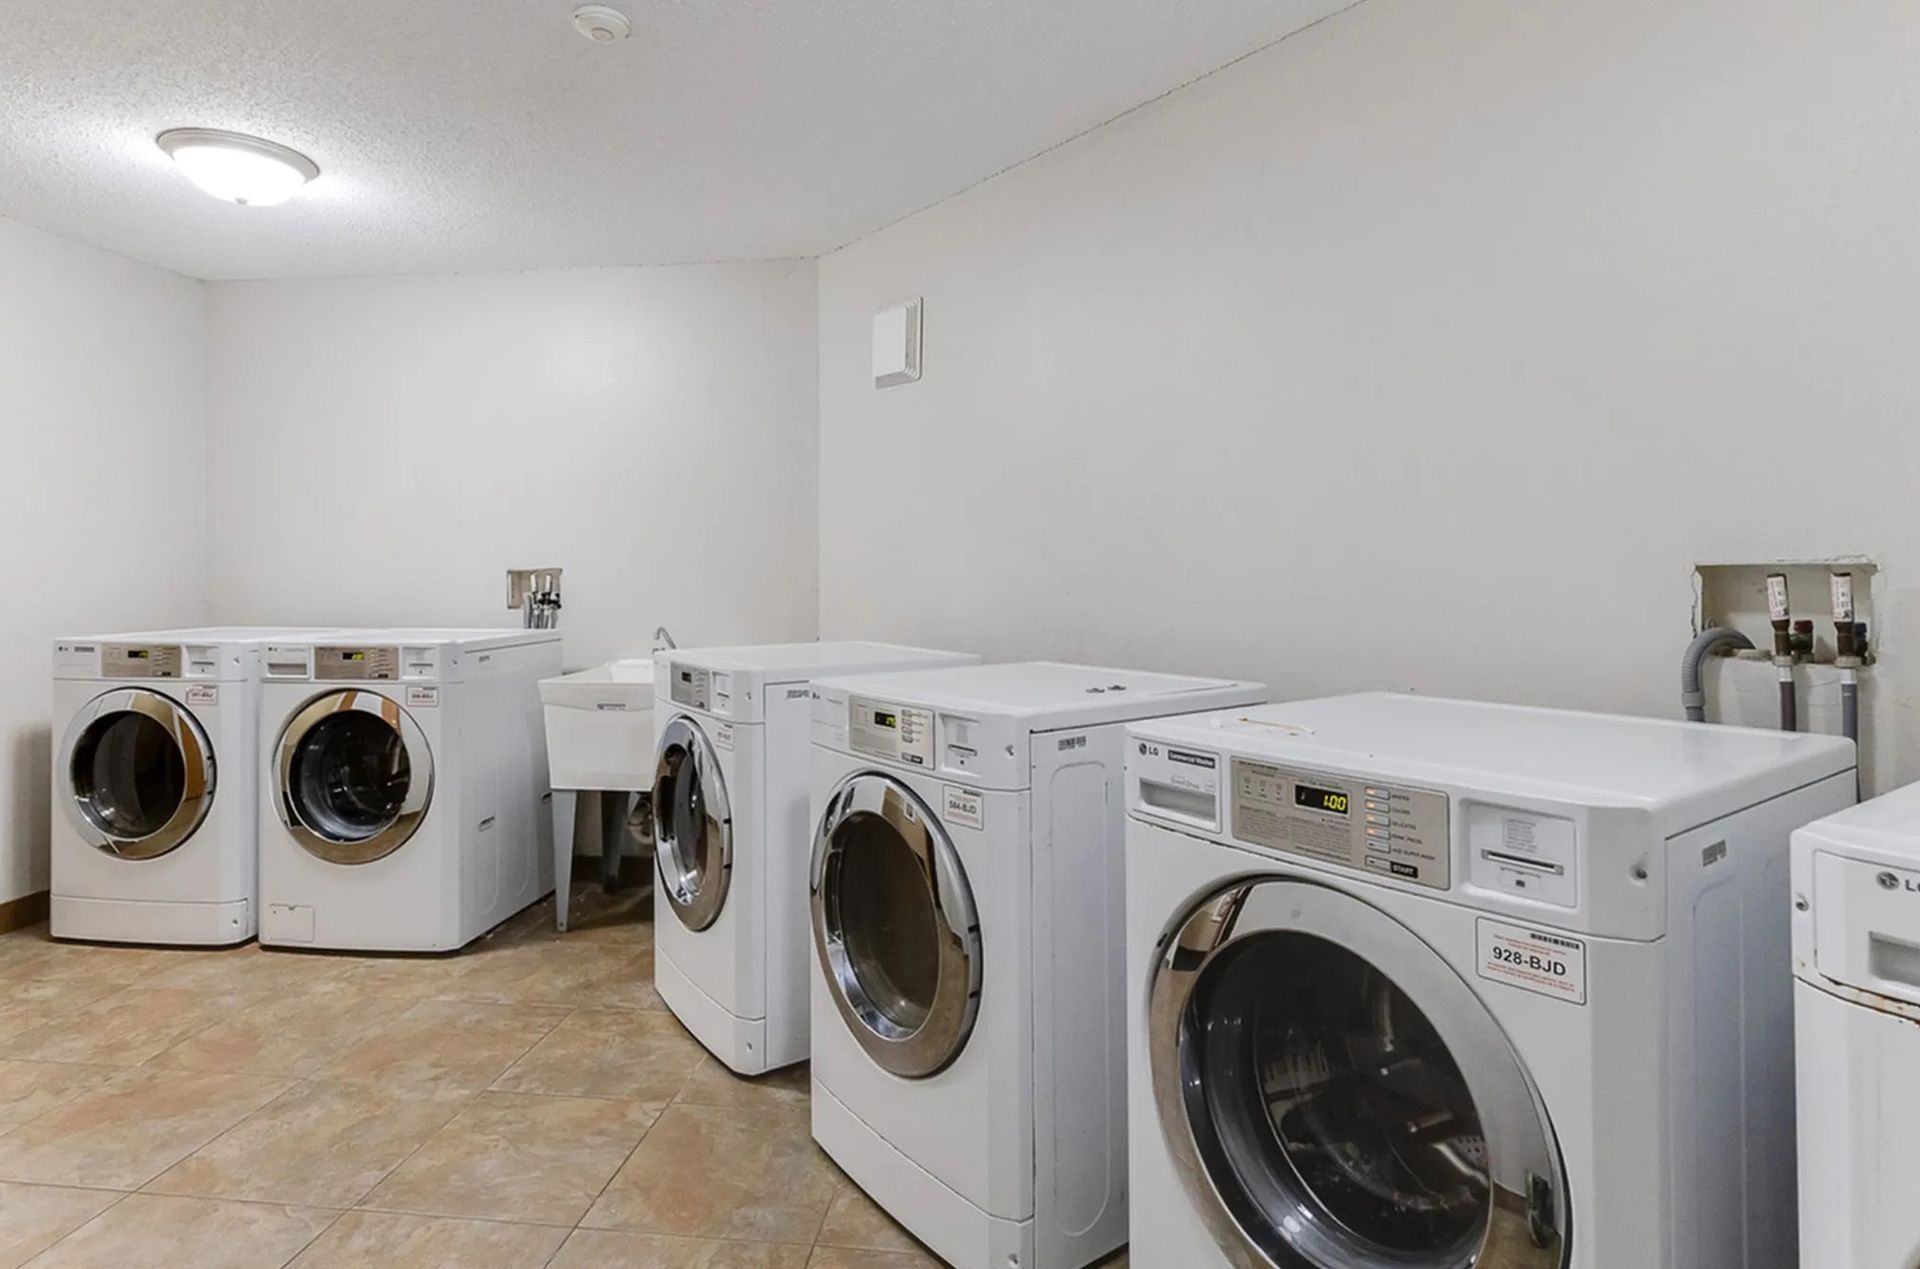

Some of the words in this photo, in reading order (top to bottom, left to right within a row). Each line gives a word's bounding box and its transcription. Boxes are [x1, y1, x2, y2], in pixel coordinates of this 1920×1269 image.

[1148, 746, 1159, 756] LG
[1393, 864, 1414, 875] START
[1493, 946, 1565, 976] 928-BJD
